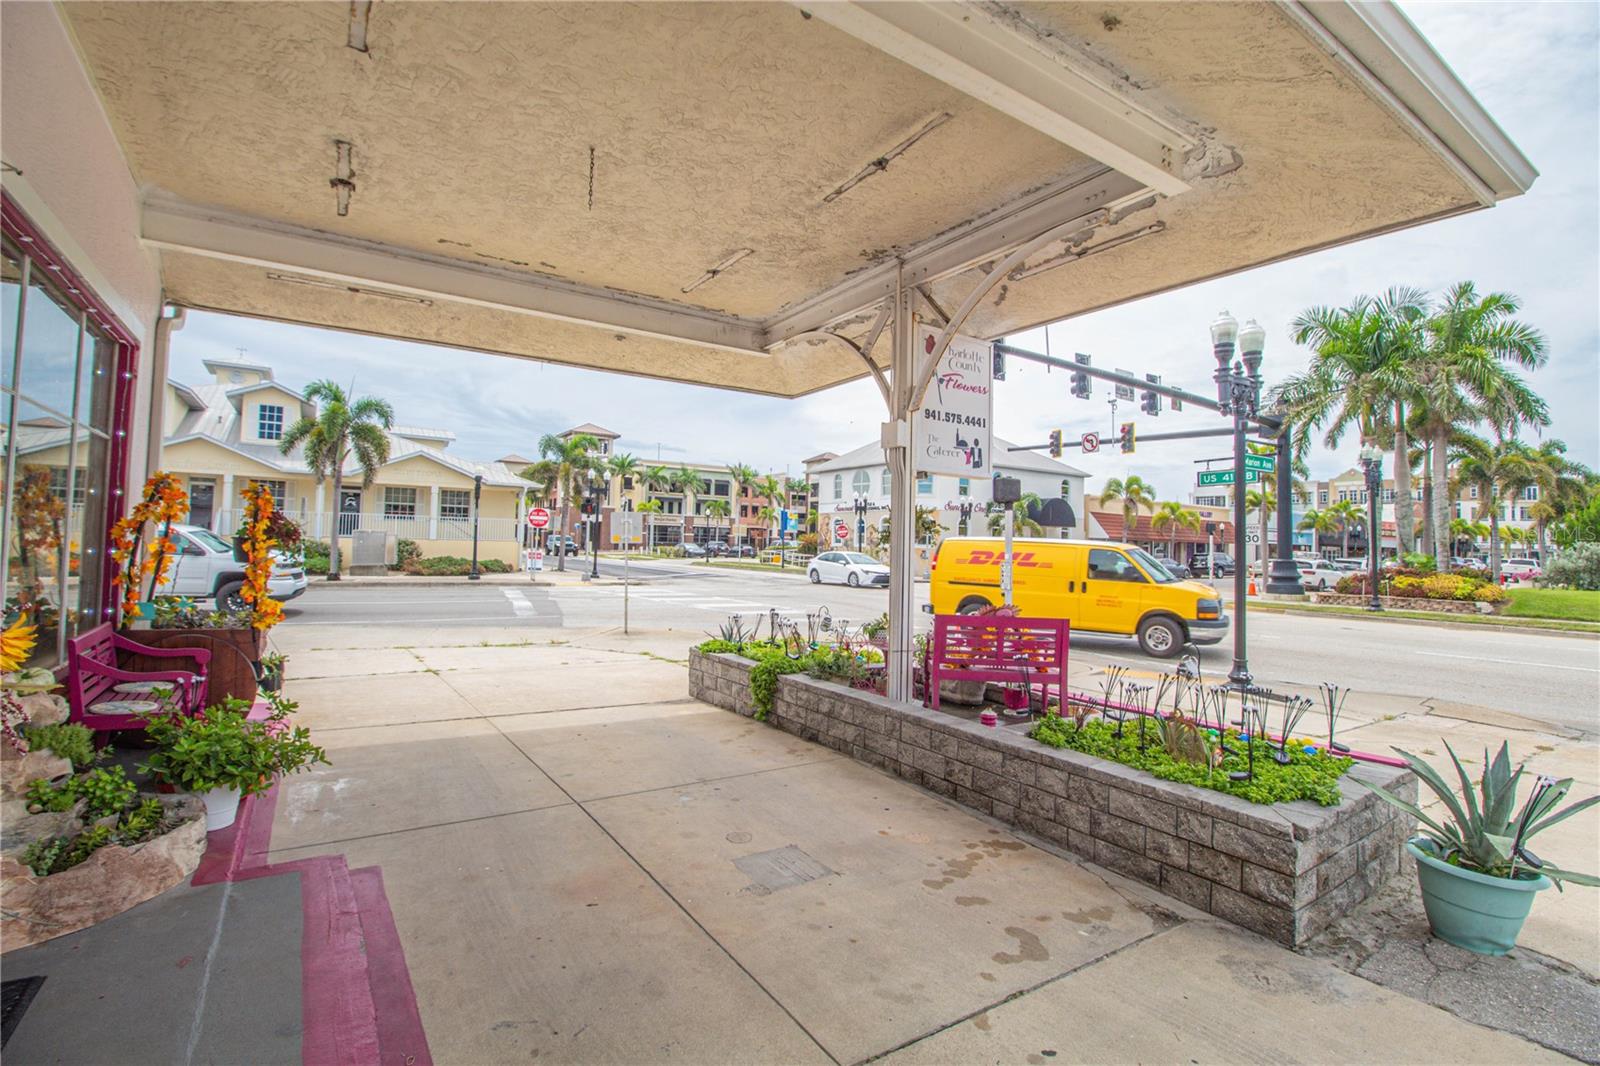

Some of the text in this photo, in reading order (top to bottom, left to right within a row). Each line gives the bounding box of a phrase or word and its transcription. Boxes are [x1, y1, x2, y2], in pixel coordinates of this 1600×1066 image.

[947, 345, 985, 364] harlotte
[948, 357, 982, 374] County
[942, 372, 989, 396] Flowers
[924, 408, 987, 429] 941.575.4441
[926, 444, 961, 460] Caterer
[1203, 475, 1217, 483] US
[1222, 473, 1234, 481] 41
[1244, 534, 1260, 543] 30
[967, 550, 1039, 568] DHL
